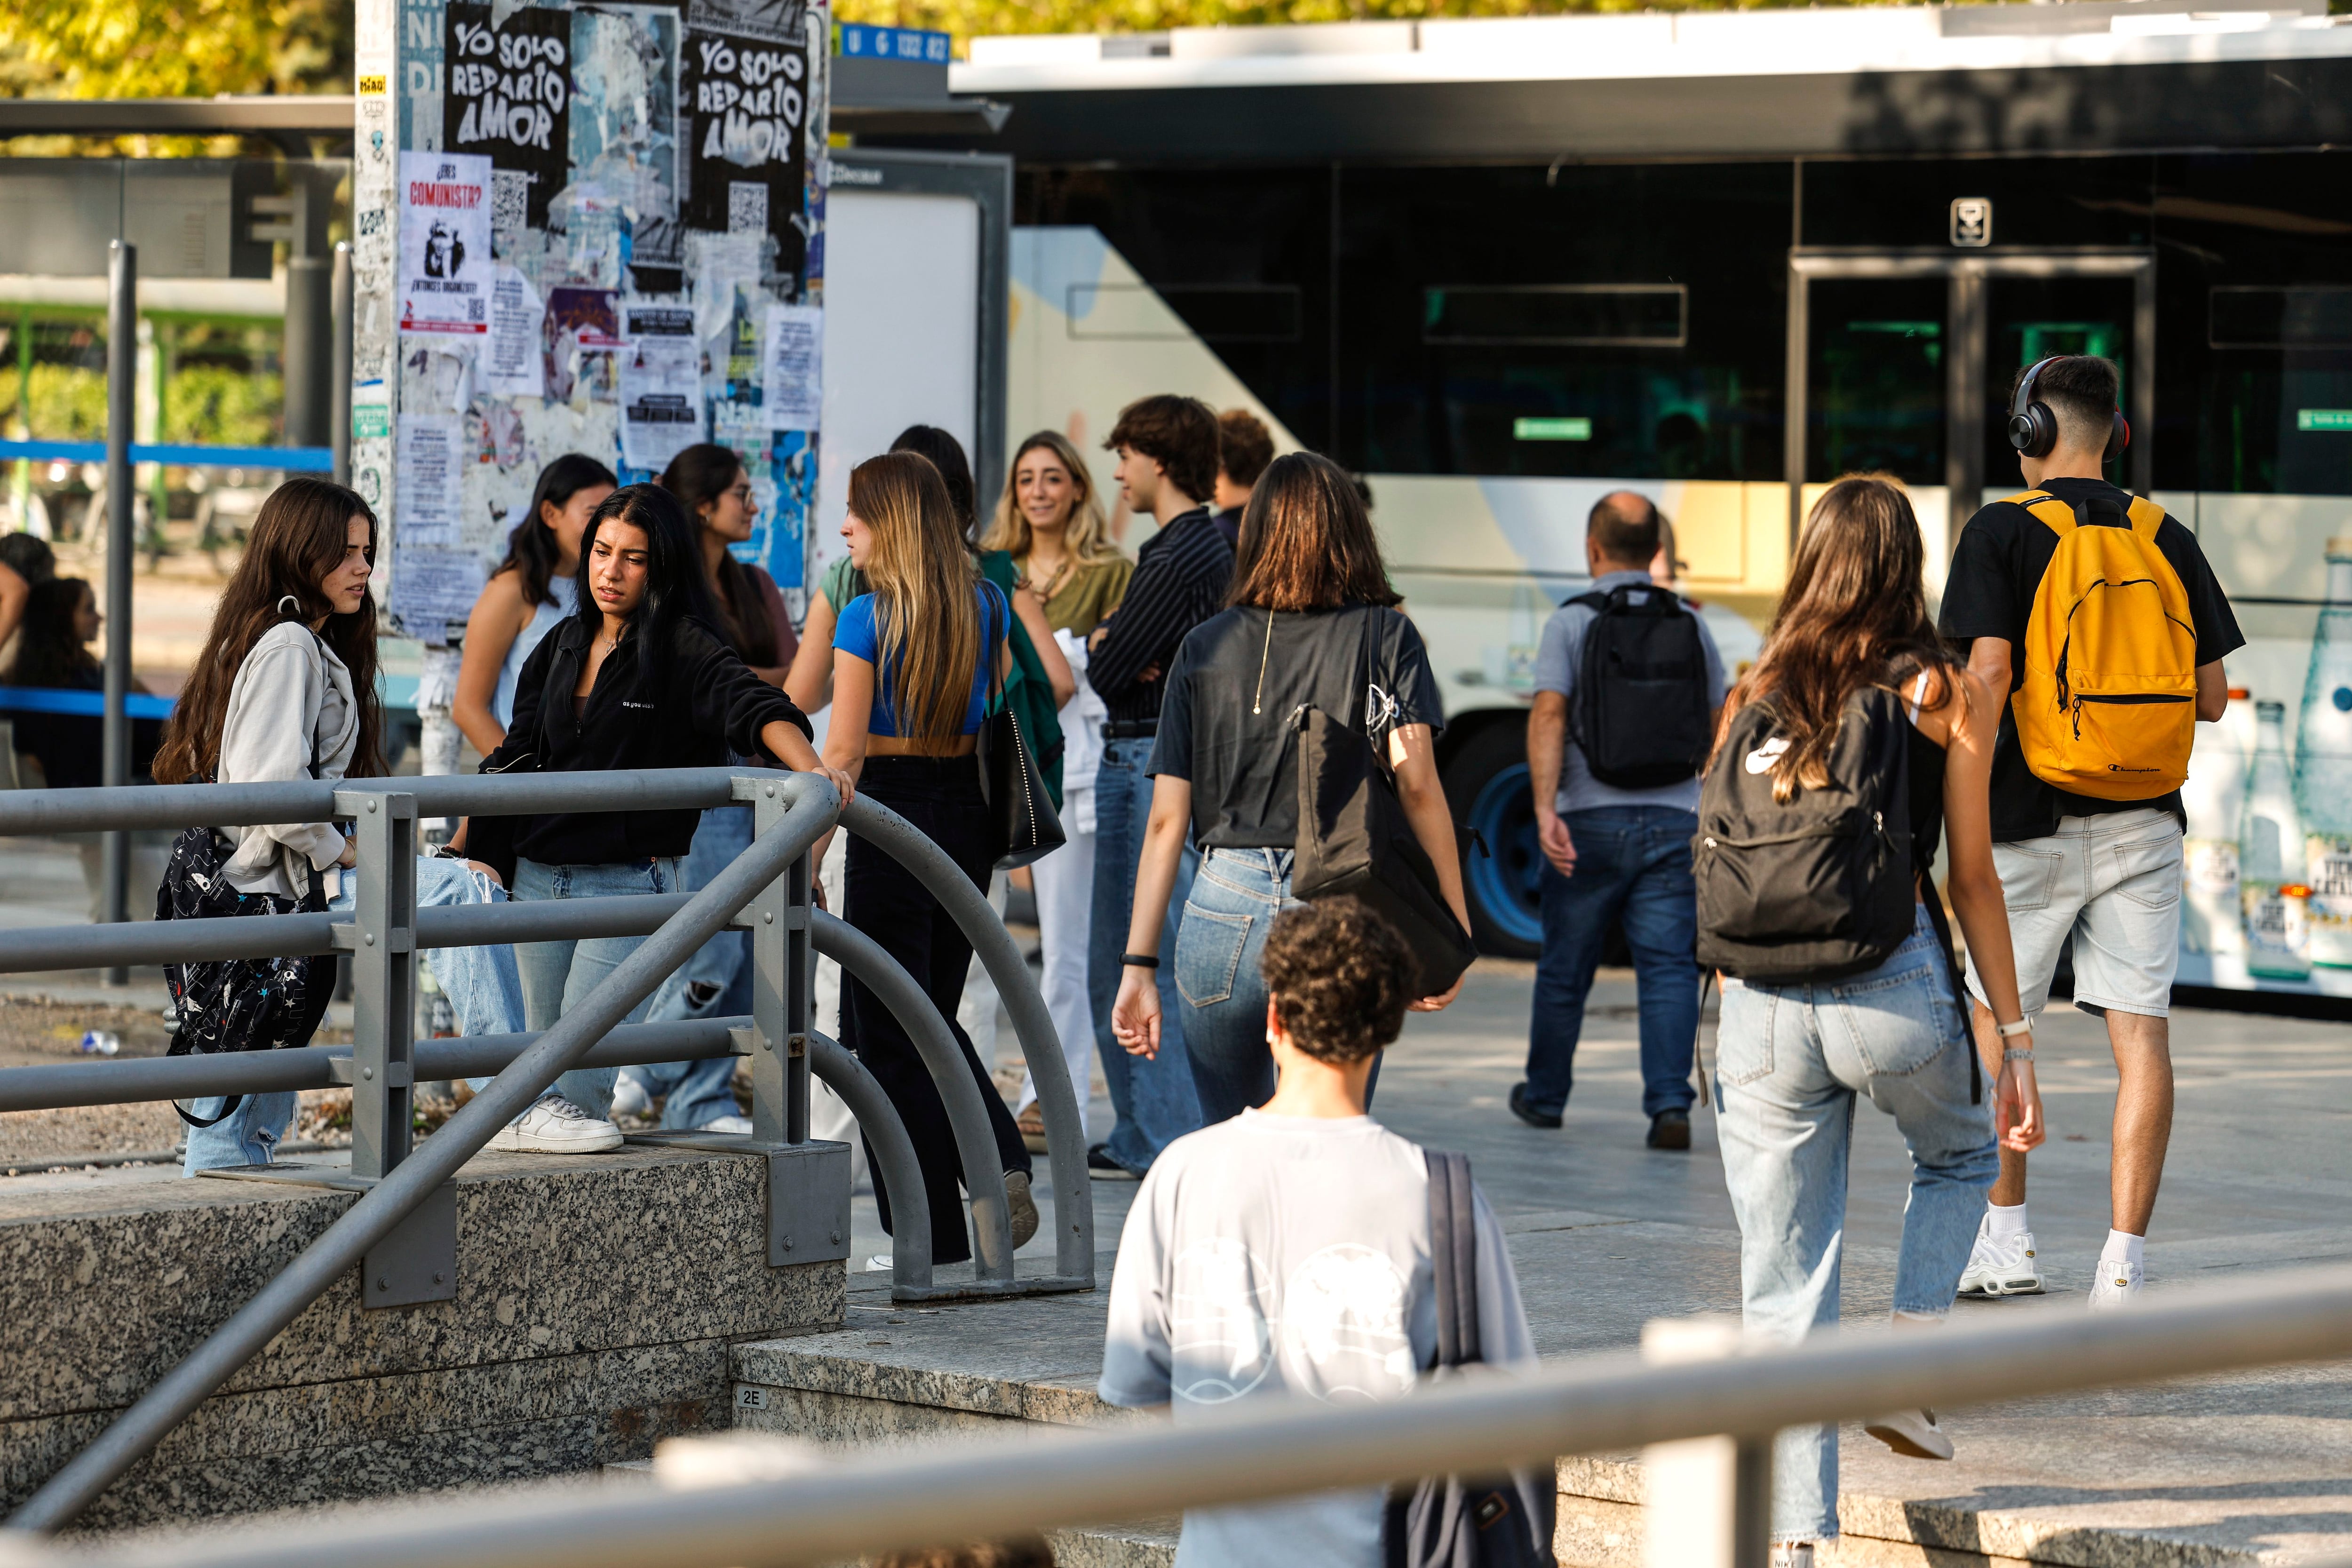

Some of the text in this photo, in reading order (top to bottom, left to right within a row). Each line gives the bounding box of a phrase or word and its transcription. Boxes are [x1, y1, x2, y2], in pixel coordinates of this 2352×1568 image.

[454, 22, 565, 69] YO SOLO
[699, 39, 803, 86] YO SOLO
[848, 29, 861, 54] U
[452, 61, 564, 114] REPARTO
[698, 78, 803, 128] REPARTO
[457, 93, 552, 150] AMOR
[702, 111, 791, 168] AMOR
[410, 181, 482, 210] COMUNISTA?
[437, 164, 455, 181] ¿ERES
[2108, 764, 2161, 774] Champion
[743, 1390, 760, 1405] 2E
